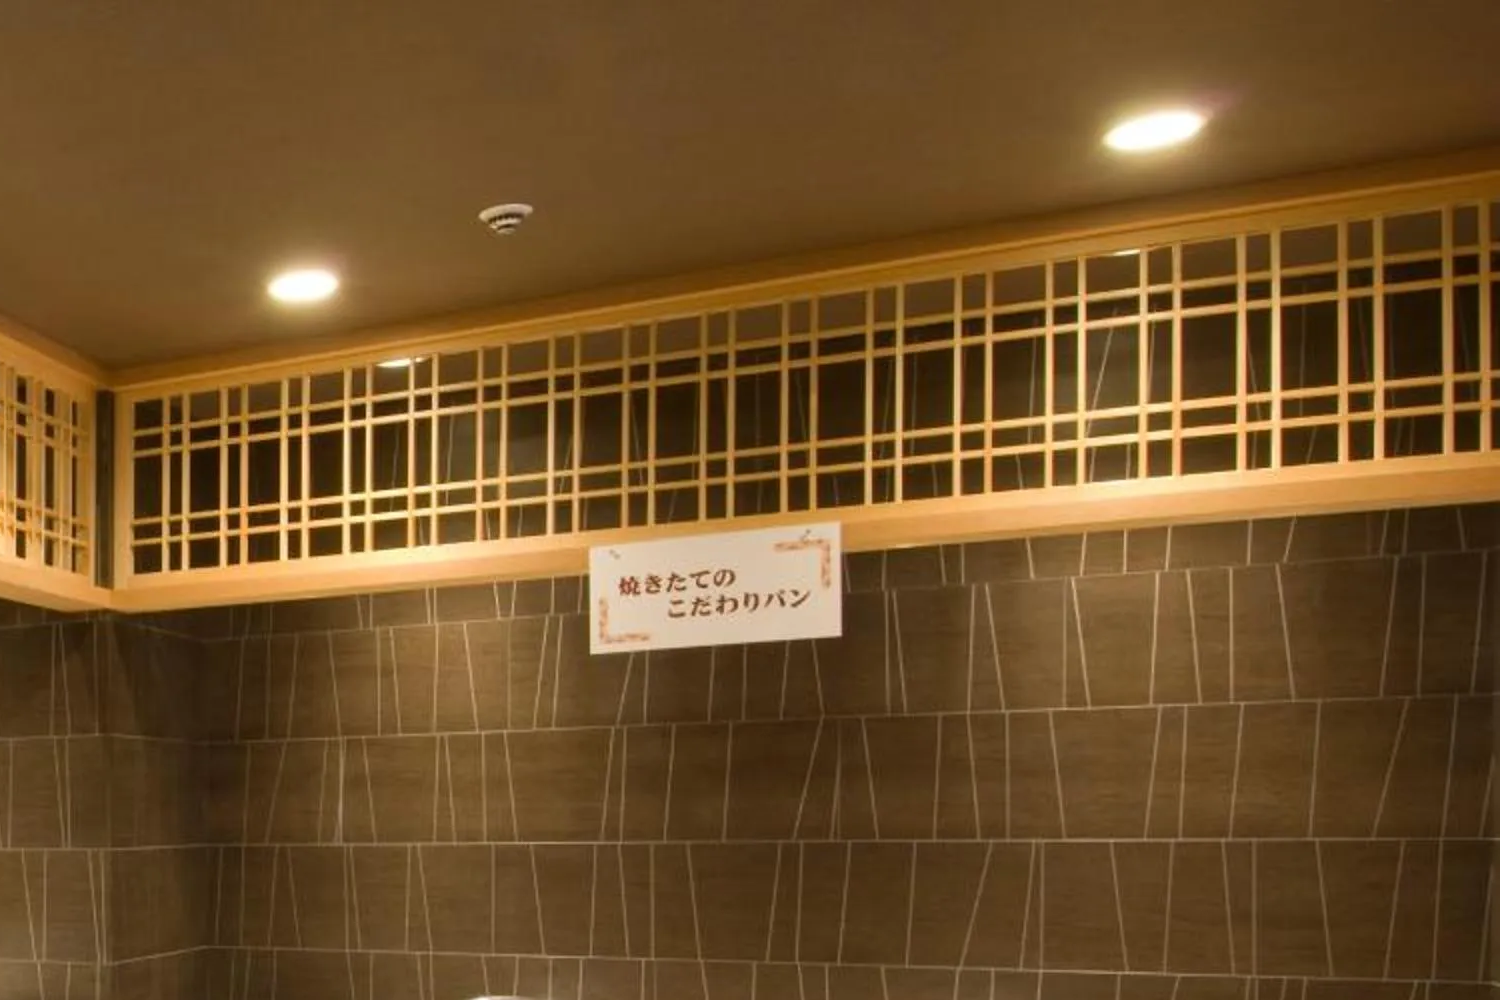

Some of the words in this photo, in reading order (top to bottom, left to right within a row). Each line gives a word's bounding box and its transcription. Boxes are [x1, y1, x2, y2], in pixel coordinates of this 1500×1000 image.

[618, 568, 736, 597] 焼きたての
[667, 590, 811, 618] こだわりパン
